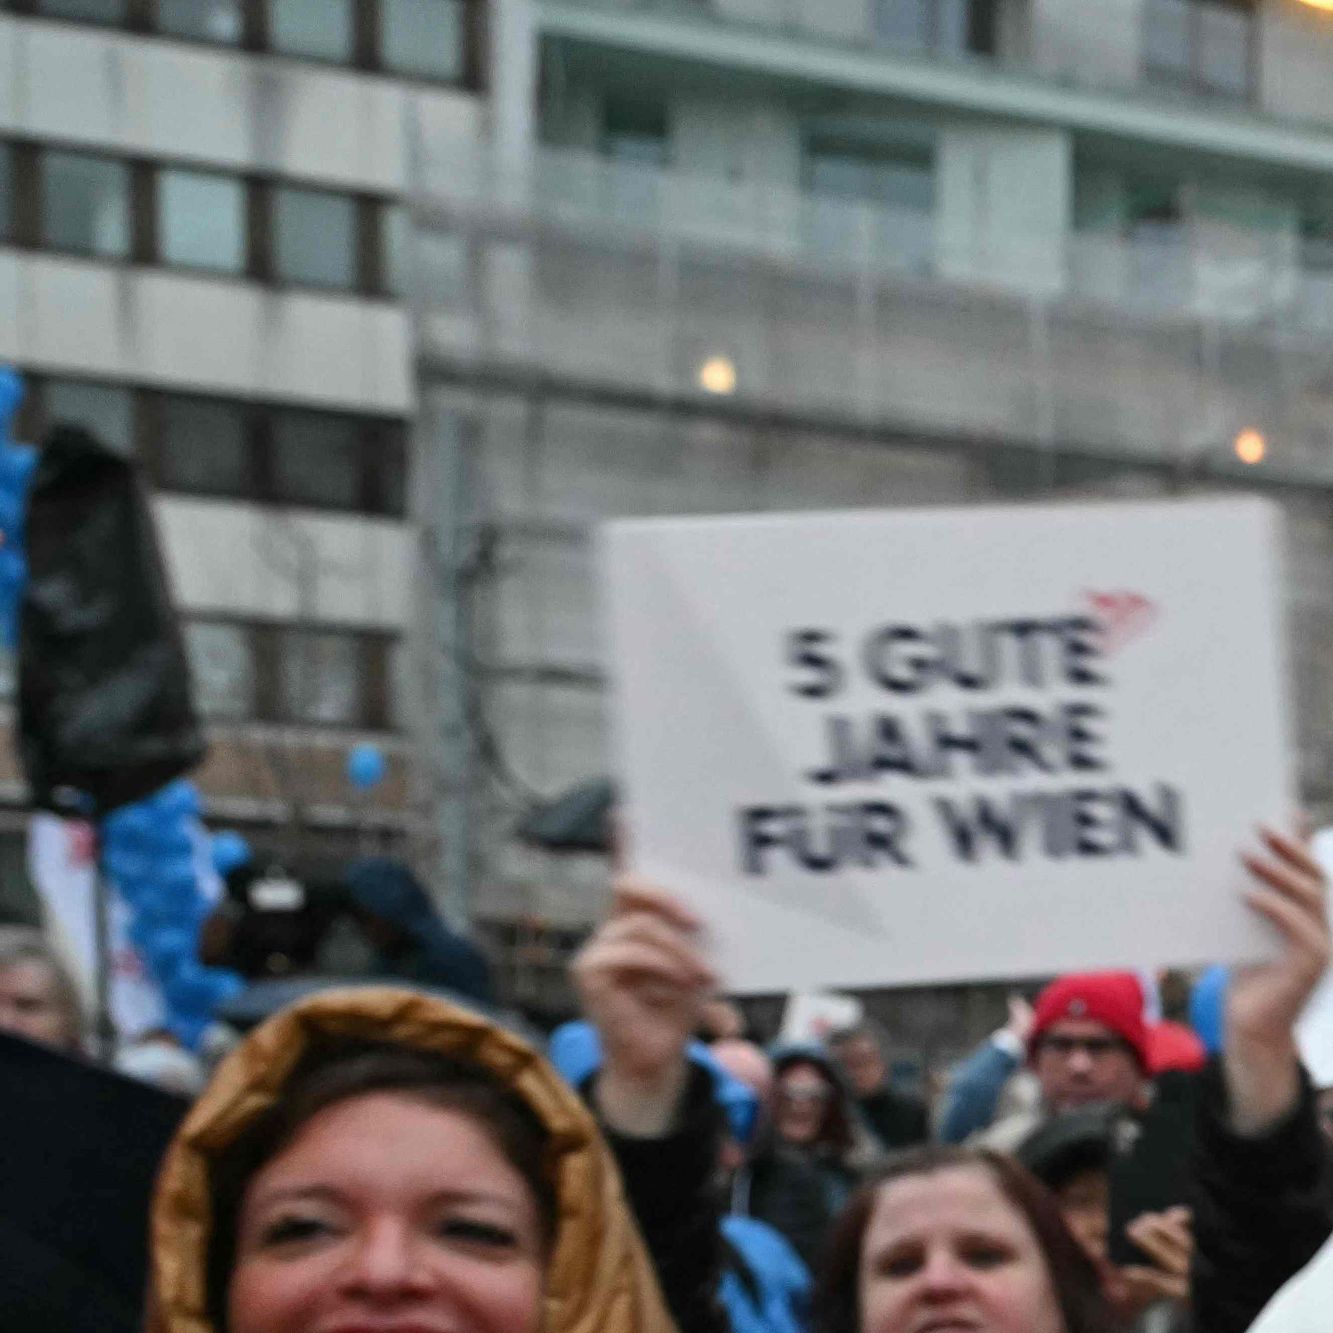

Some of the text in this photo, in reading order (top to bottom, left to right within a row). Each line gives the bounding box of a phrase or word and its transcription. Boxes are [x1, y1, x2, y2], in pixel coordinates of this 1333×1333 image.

[785, 612, 1108, 697] 5 GUTE
[806, 702, 1106, 784] JAHRE
[738, 783, 1183, 876] FÜR WIEN
